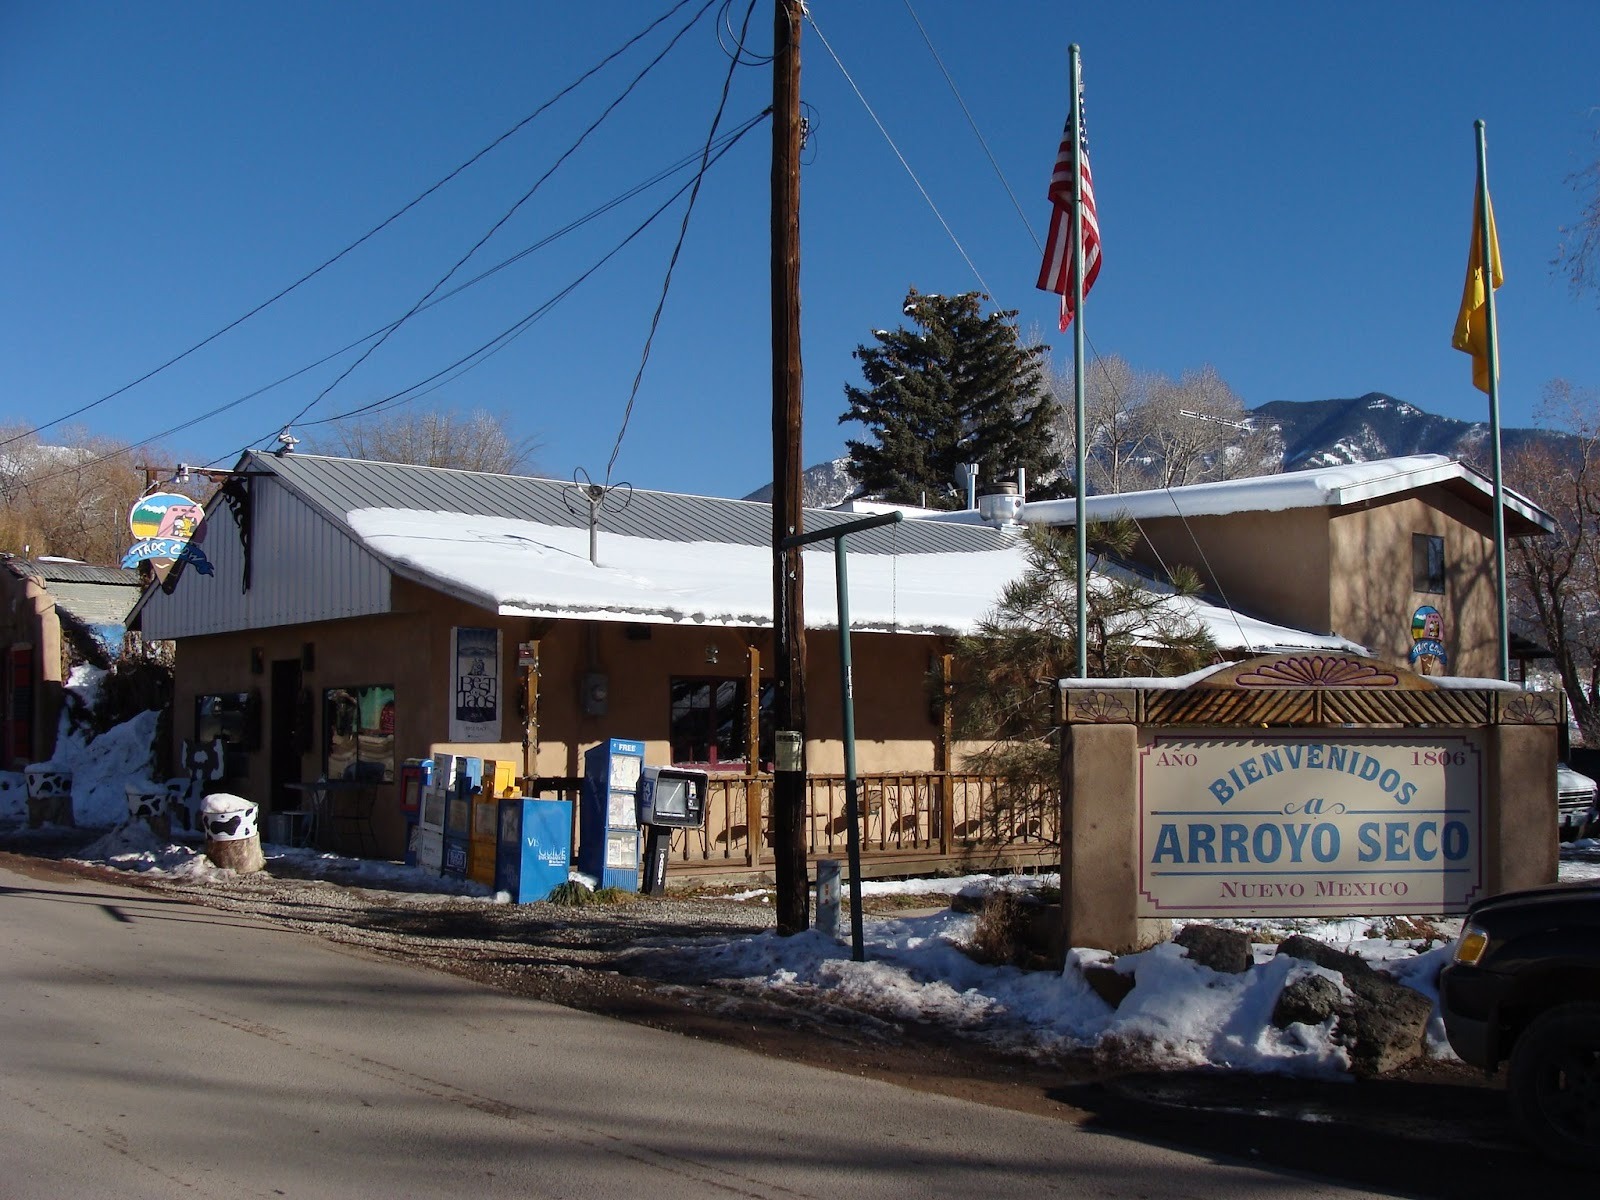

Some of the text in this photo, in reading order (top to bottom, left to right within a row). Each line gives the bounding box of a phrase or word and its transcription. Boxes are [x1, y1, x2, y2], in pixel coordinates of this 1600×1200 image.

[131, 542, 204, 560] TAOS COW
[618, 743, 636, 752] FREE
[1156, 748, 1198, 767] AÑO
[1411, 751, 1466, 767] 1806
[1208, 744, 1418, 806] BIENVENIDOS
[1151, 821, 1469, 864] ARROYO SECO
[1219, 880, 1409, 898] NUEVO MEXICO
